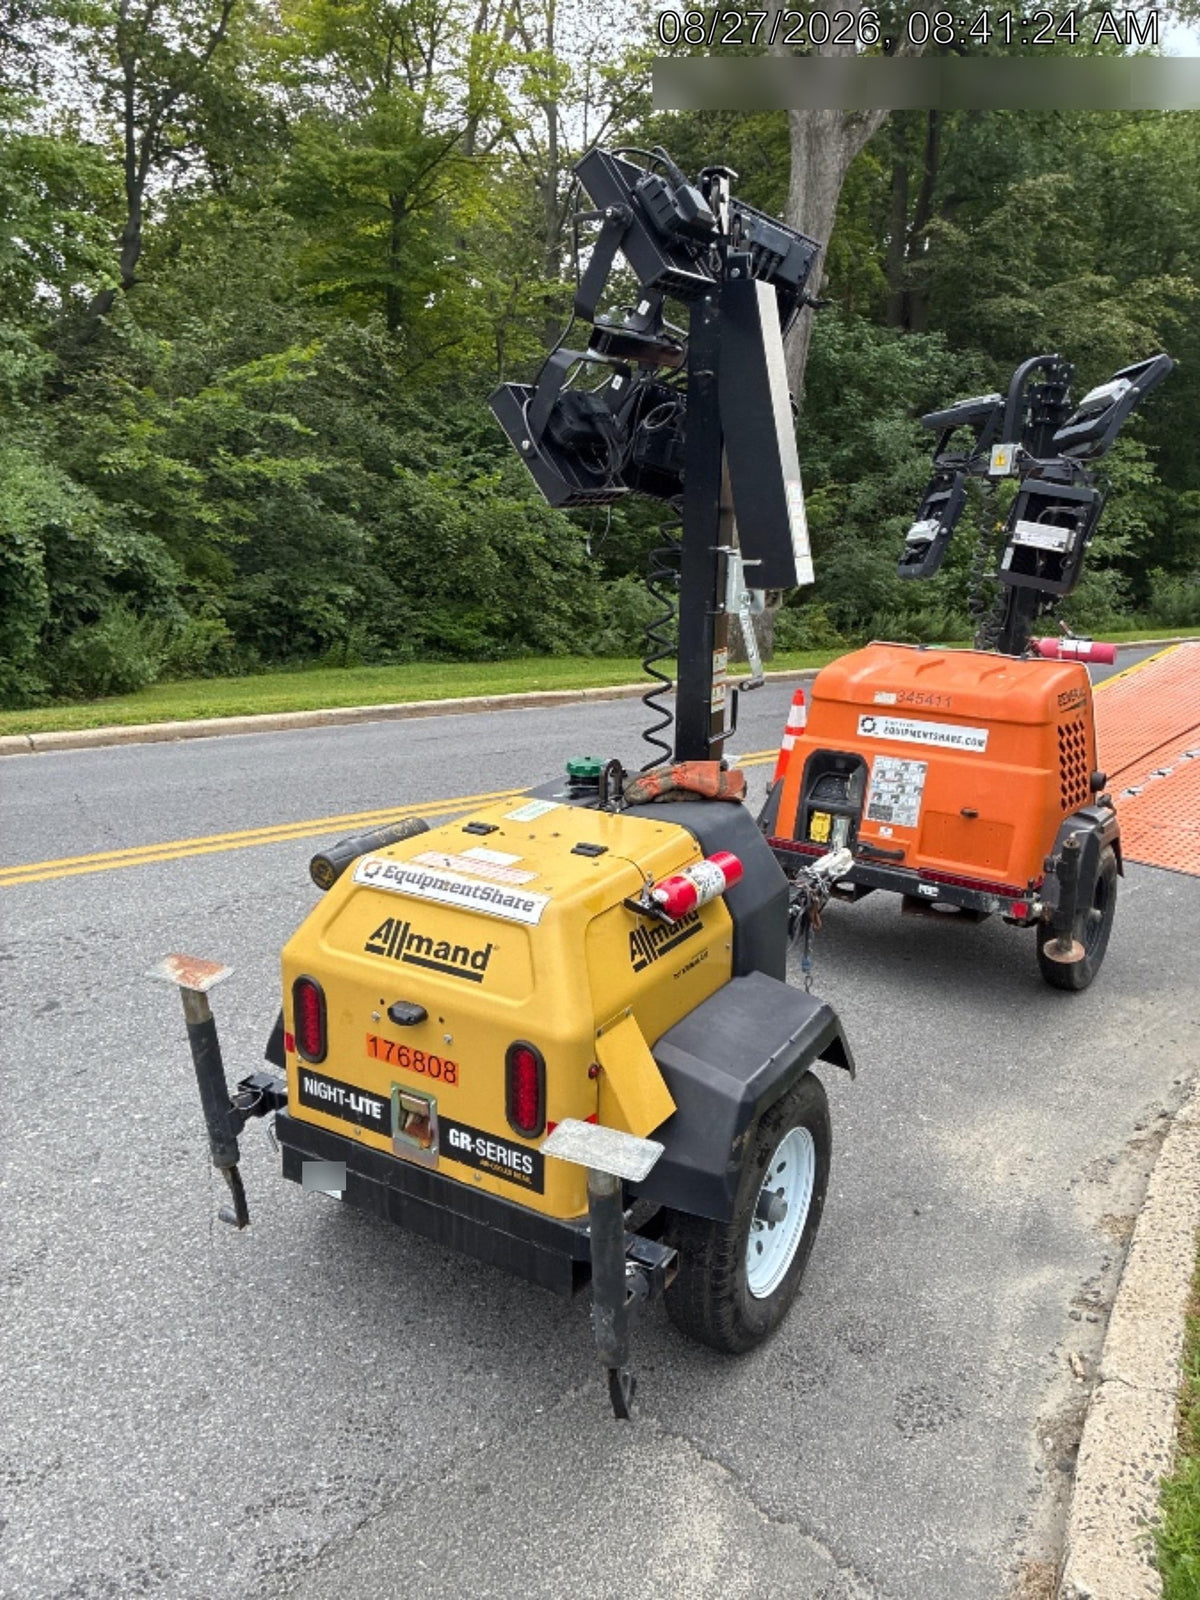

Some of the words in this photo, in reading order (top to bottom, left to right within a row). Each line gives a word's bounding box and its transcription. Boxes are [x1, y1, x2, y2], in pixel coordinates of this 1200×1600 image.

[382, 865, 535, 913] EquipmentShare
[367, 917, 493, 972] Allmand
[368, 1035, 457, 1085] 176808
[303, 1076, 384, 1120] NIGHT-LITE
[449, 1128, 533, 1175] GR-SERIES
